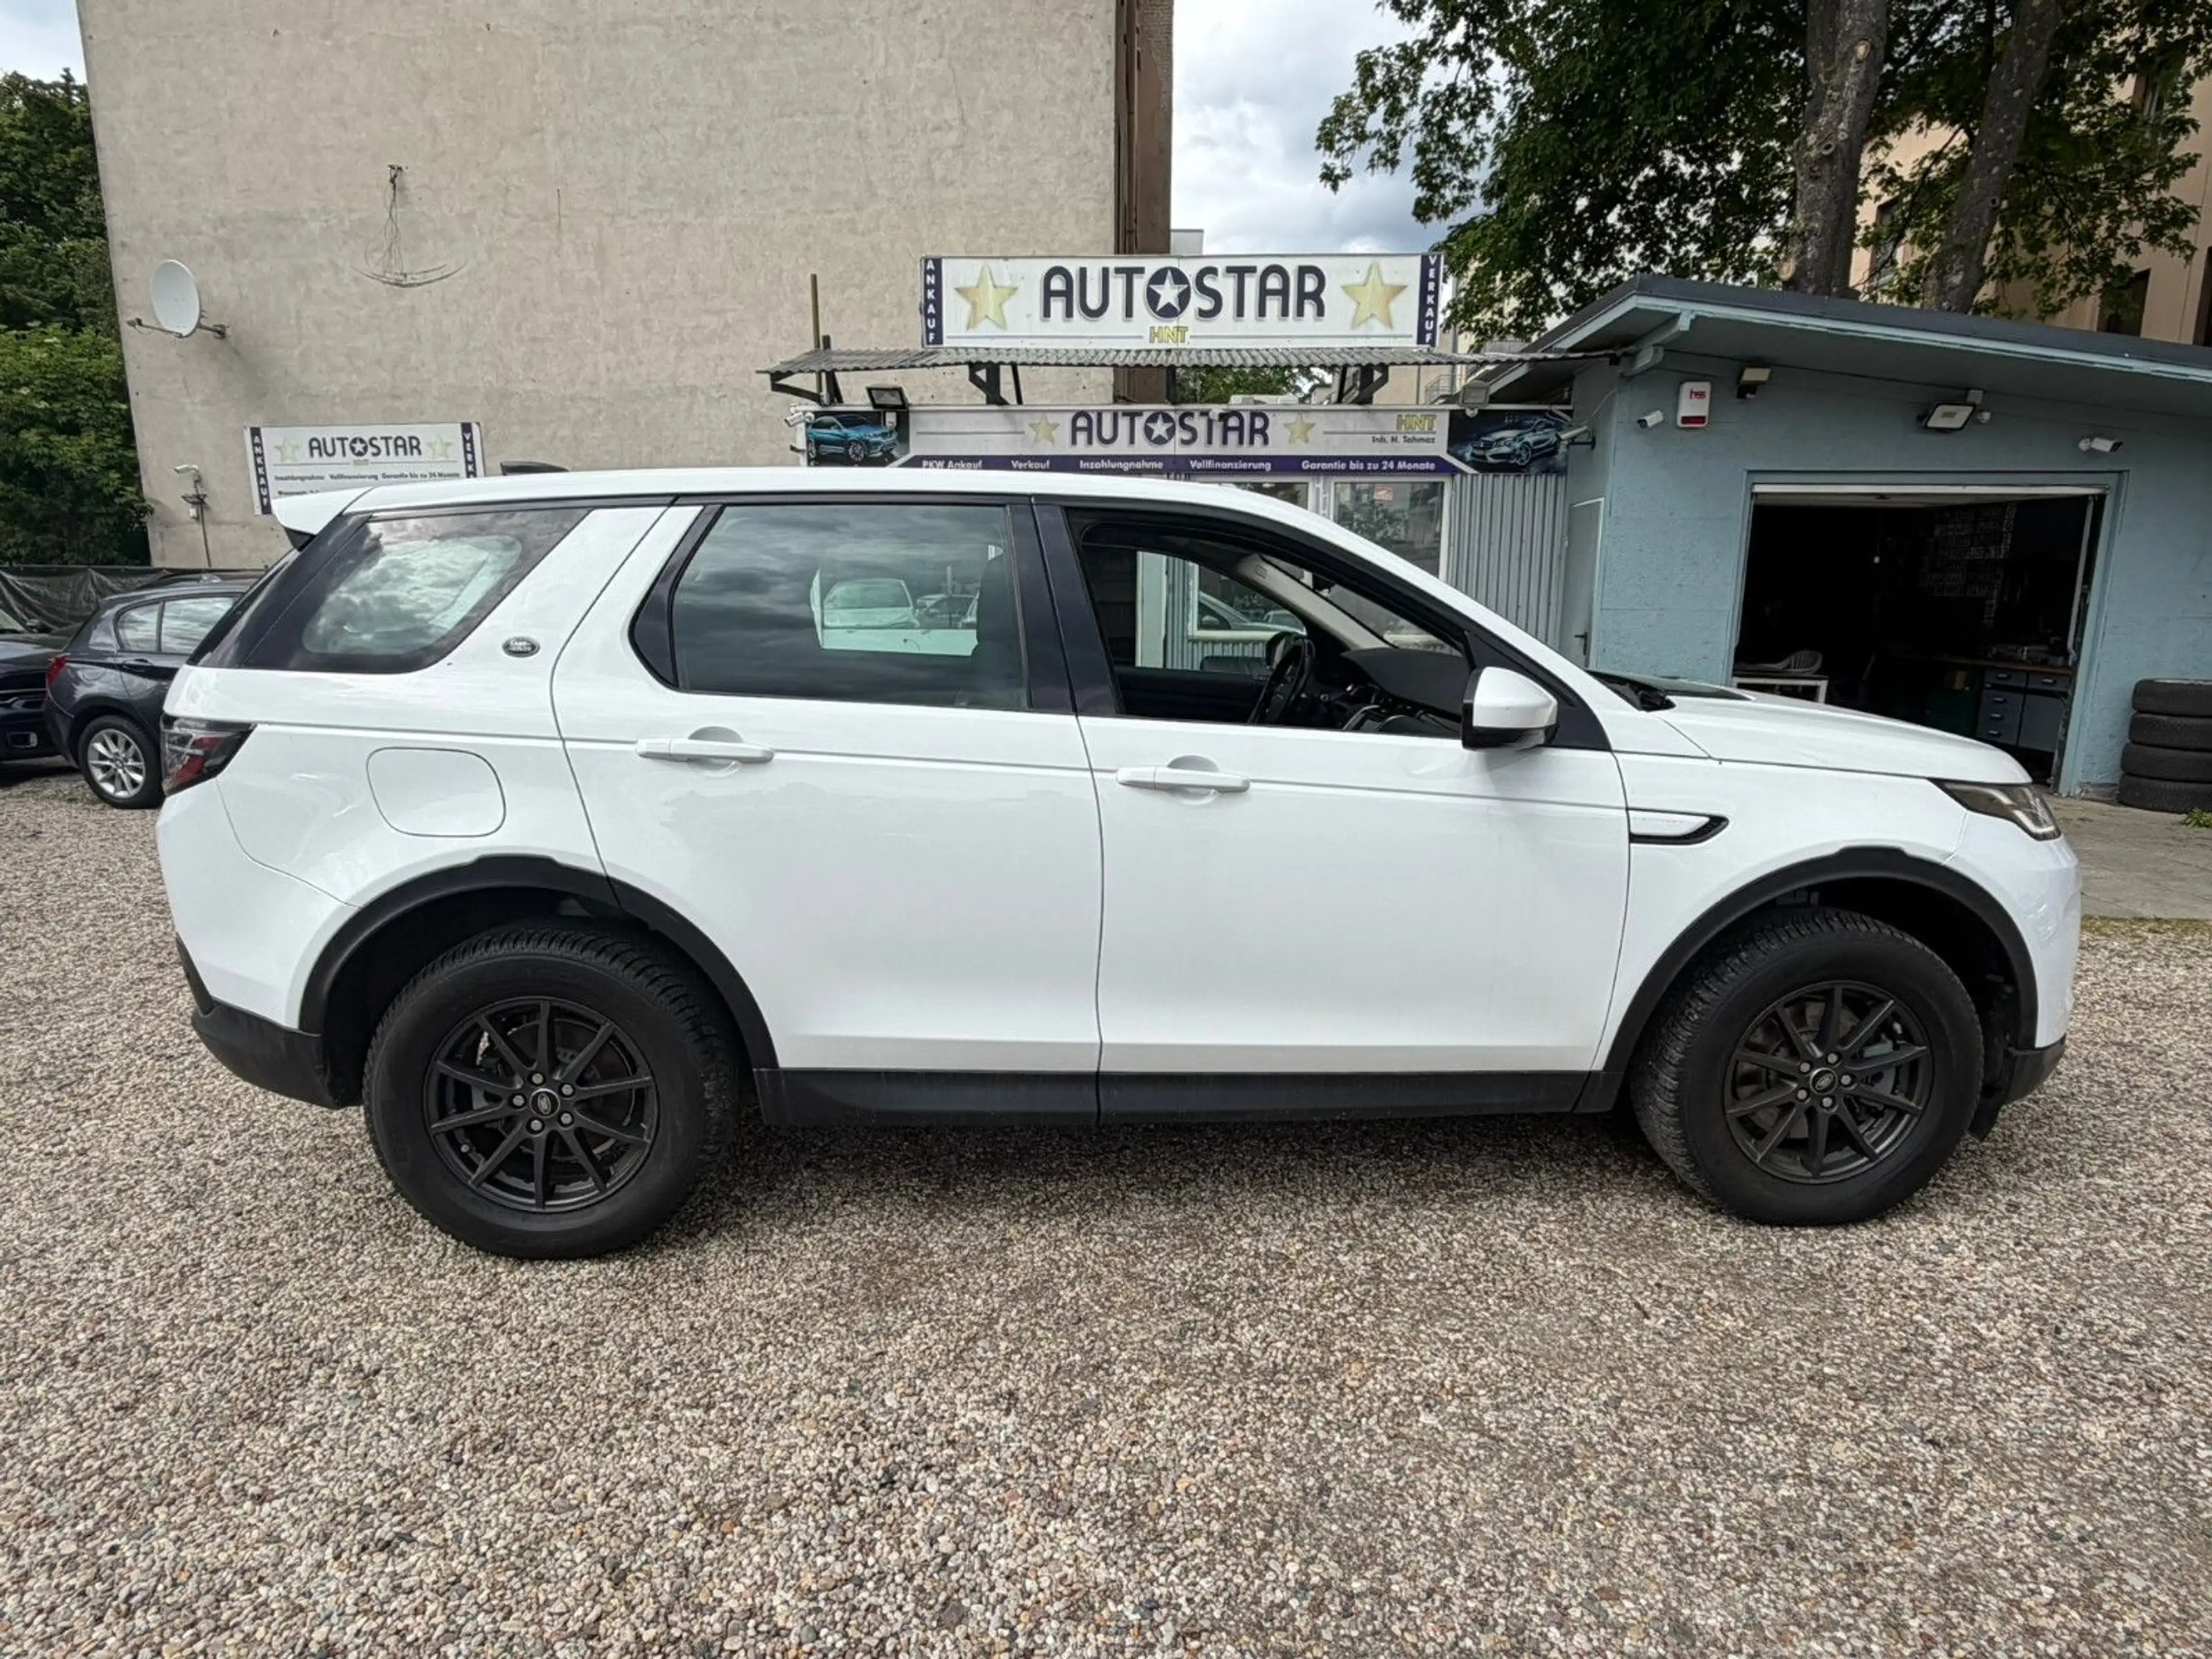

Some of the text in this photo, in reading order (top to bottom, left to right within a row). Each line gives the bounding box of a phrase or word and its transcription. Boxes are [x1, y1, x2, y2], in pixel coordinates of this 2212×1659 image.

[926, 258, 935, 343] ANKAUF
[1041, 264, 1326, 320] AUTOSTAR
[1425, 253, 1437, 343] VERKAUF
[1149, 325, 1188, 343] HNT
[1071, 410, 1270, 445] AUTOSTAR
[1396, 414, 1437, 430] HNT
[309, 436, 422, 458] AUTOSTAR
[463, 432, 475, 478] VERK
[922, 460, 945, 468] PKW
[947, 460, 983, 469] Ankauf
[1011, 460, 1050, 469] Verkauf
[1079, 460, 1163, 471] Inzahlungnahme
[1190, 460, 1271, 472] Vollfinanzierung
[1302, 460, 1347, 469] Garantie
[1350, 460, 1364, 469] bis
[1382, 460, 1394, 469] 24
[1397, 460, 1435, 469] Monate
[254, 435, 268, 506] ANKAUF
